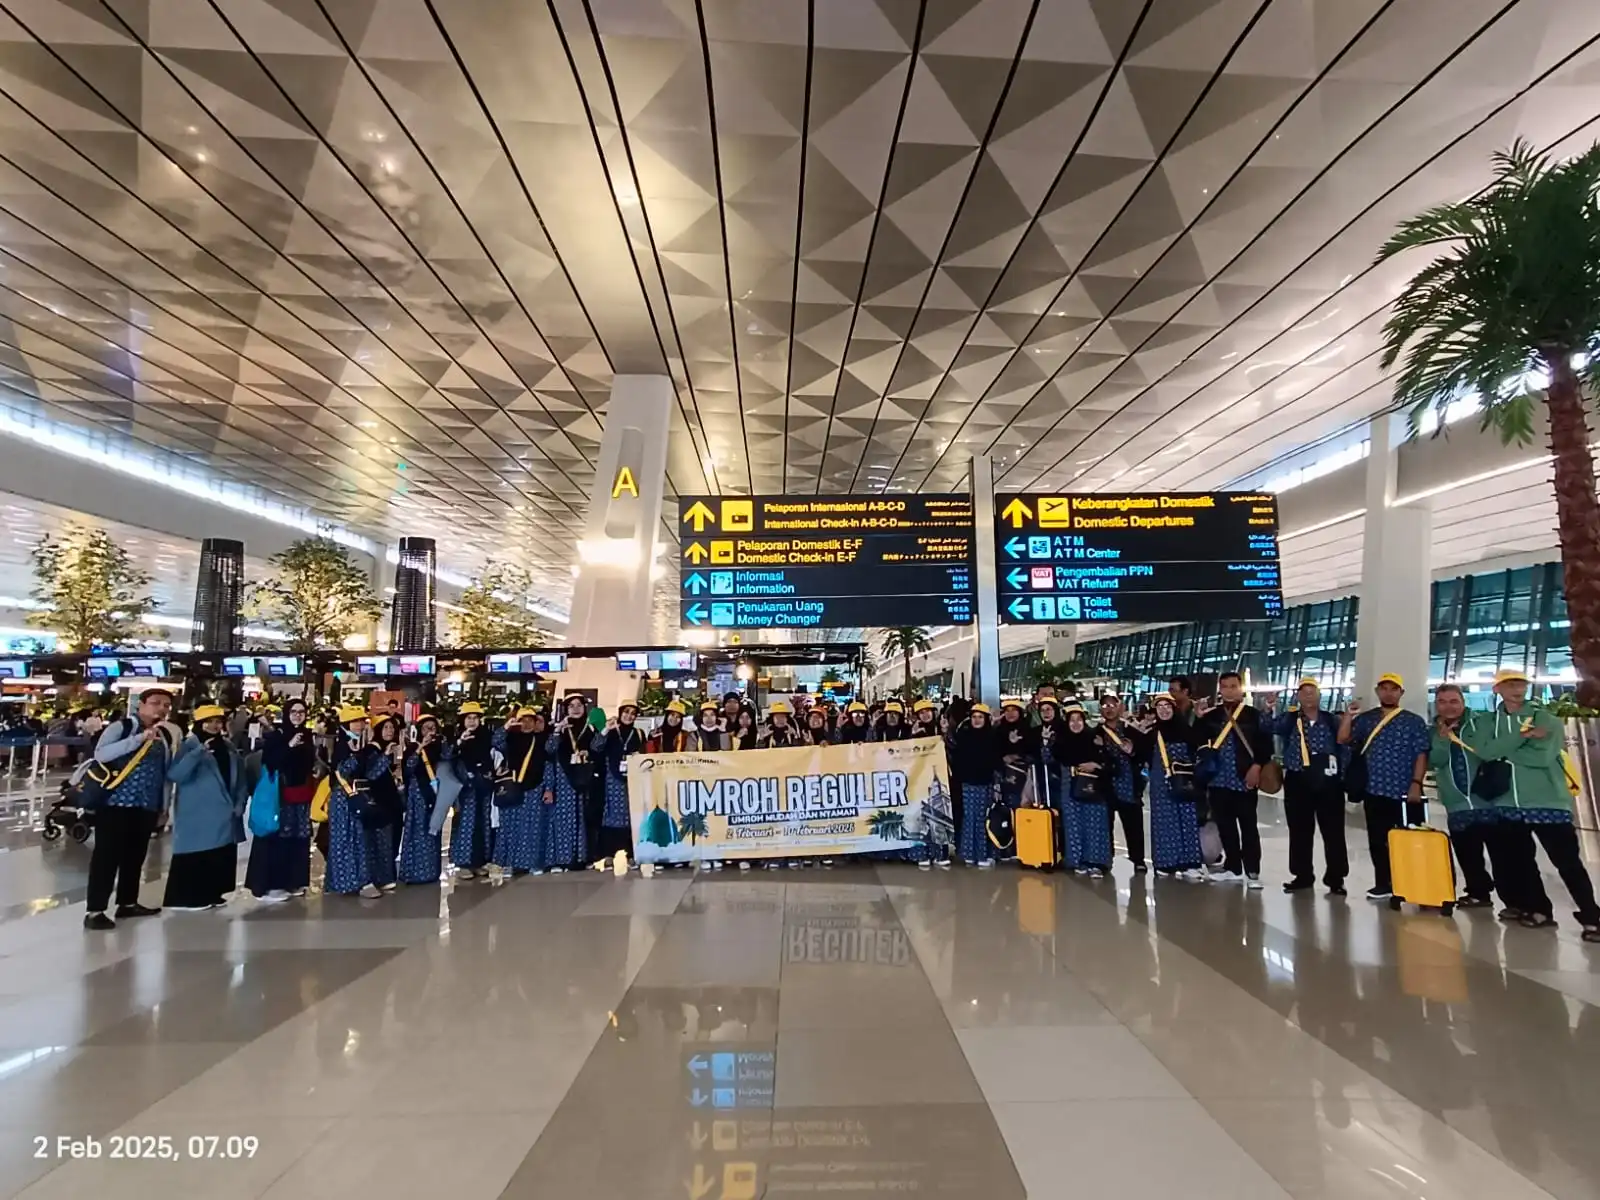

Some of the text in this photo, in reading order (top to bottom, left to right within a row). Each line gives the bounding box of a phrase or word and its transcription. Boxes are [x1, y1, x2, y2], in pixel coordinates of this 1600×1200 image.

[612, 466, 638, 498] A
[764, 503, 808, 514] Pelaporan
[868, 501, 906, 511] A-B-C-D
[1072, 497, 1158, 511] Keberangkatan
[1160, 496, 1215, 508] Domestik
[764, 519, 819, 529] International
[820, 518, 859, 528] Check-in
[861, 518, 898, 528] A-B-C-D
[1074, 516, 1195, 529] Domestic Departures
[737, 538, 863, 552] Pelaporan Domestik E-F
[1053, 536, 1084, 546] ATM
[737, 551, 857, 563] Domestic Check-in E-F
[1054, 548, 1121, 558] ATM Center
[736, 571, 785, 581] Informasi
[1034, 569, 1049, 577] VAT
[1056, 565, 1154, 578] Pengembalian PPN
[736, 584, 795, 594] Information
[1056, 579, 1119, 589] VAT Refund
[737, 601, 824, 613] Penukaran Uang
[1083, 597, 1112, 607] Toilet
[1083, 609, 1119, 619] Toilets
[737, 614, 821, 626] Money Changer
[678, 770, 909, 816] UMROH REGULER
[731, 815, 764, 824] UMROH
